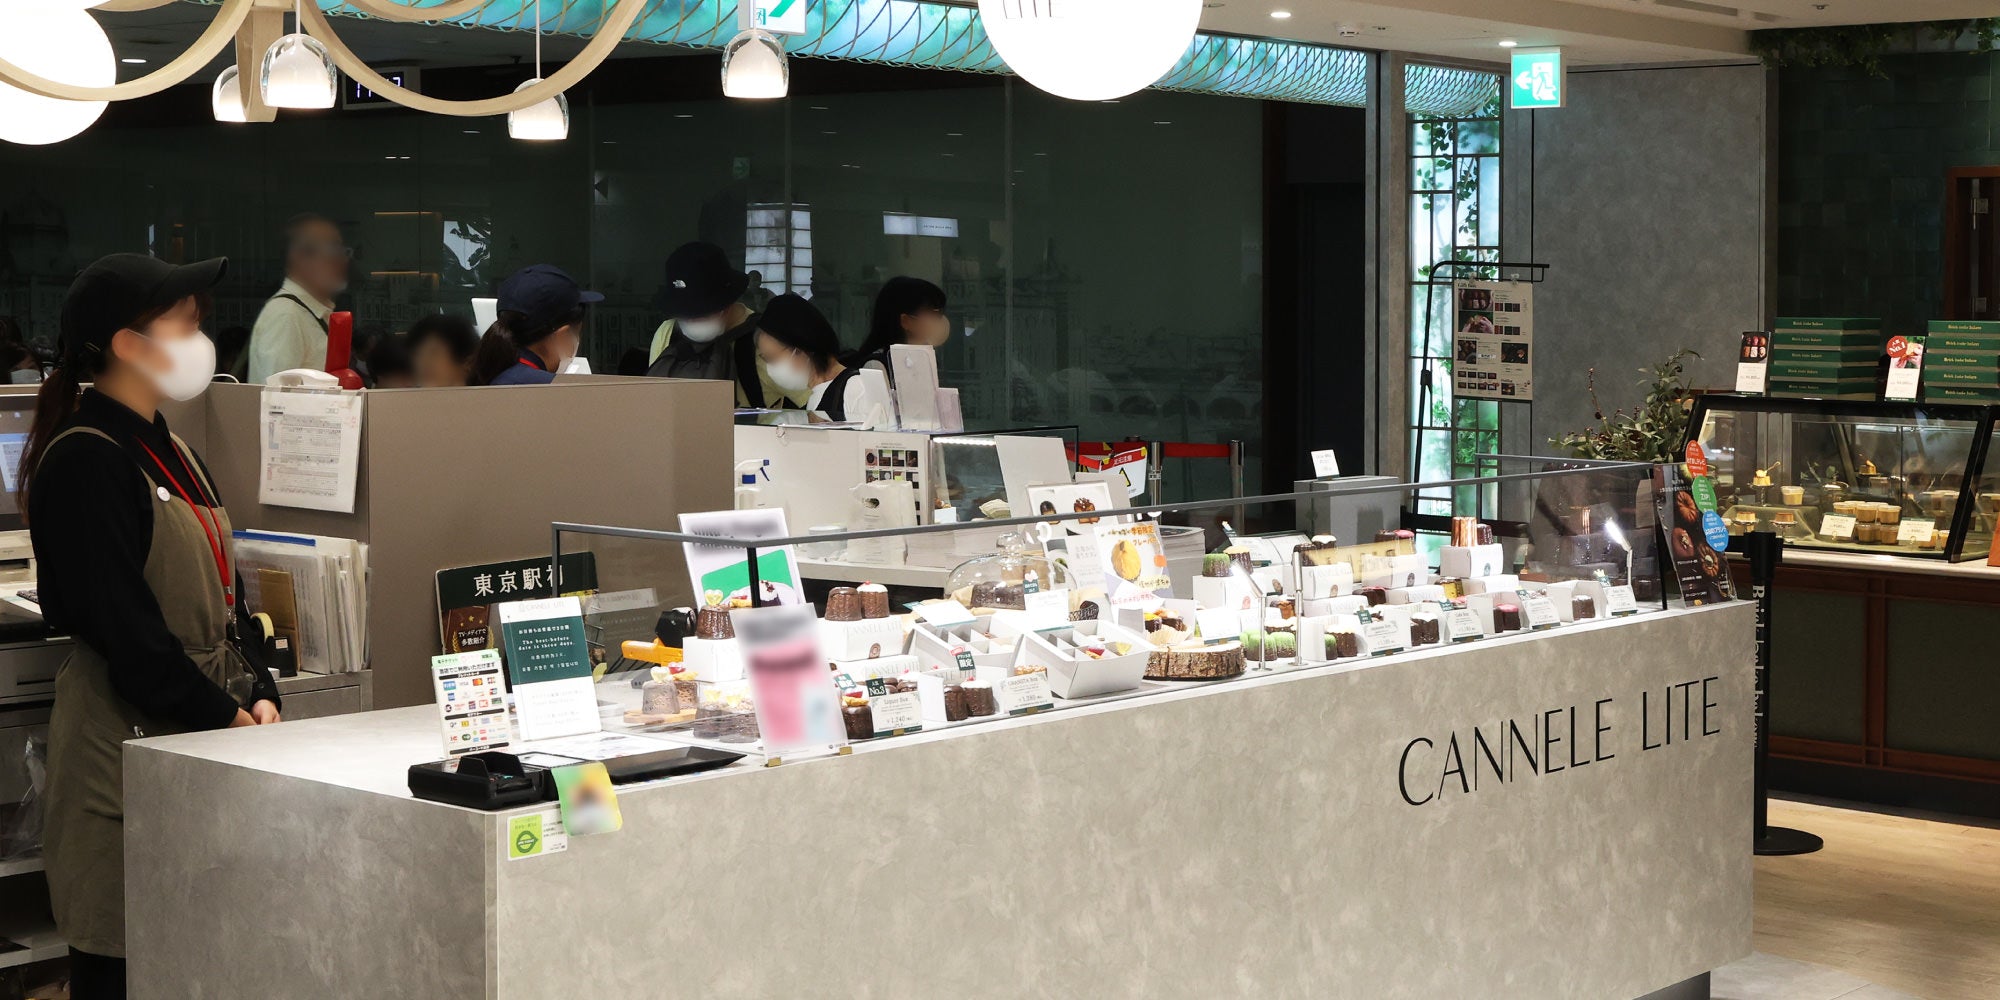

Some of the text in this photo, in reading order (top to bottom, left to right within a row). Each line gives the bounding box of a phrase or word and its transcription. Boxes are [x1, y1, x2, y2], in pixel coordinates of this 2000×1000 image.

[868, 686, 886, 698] No.3
[1398, 676, 1720, 806] CANNELE LITE
